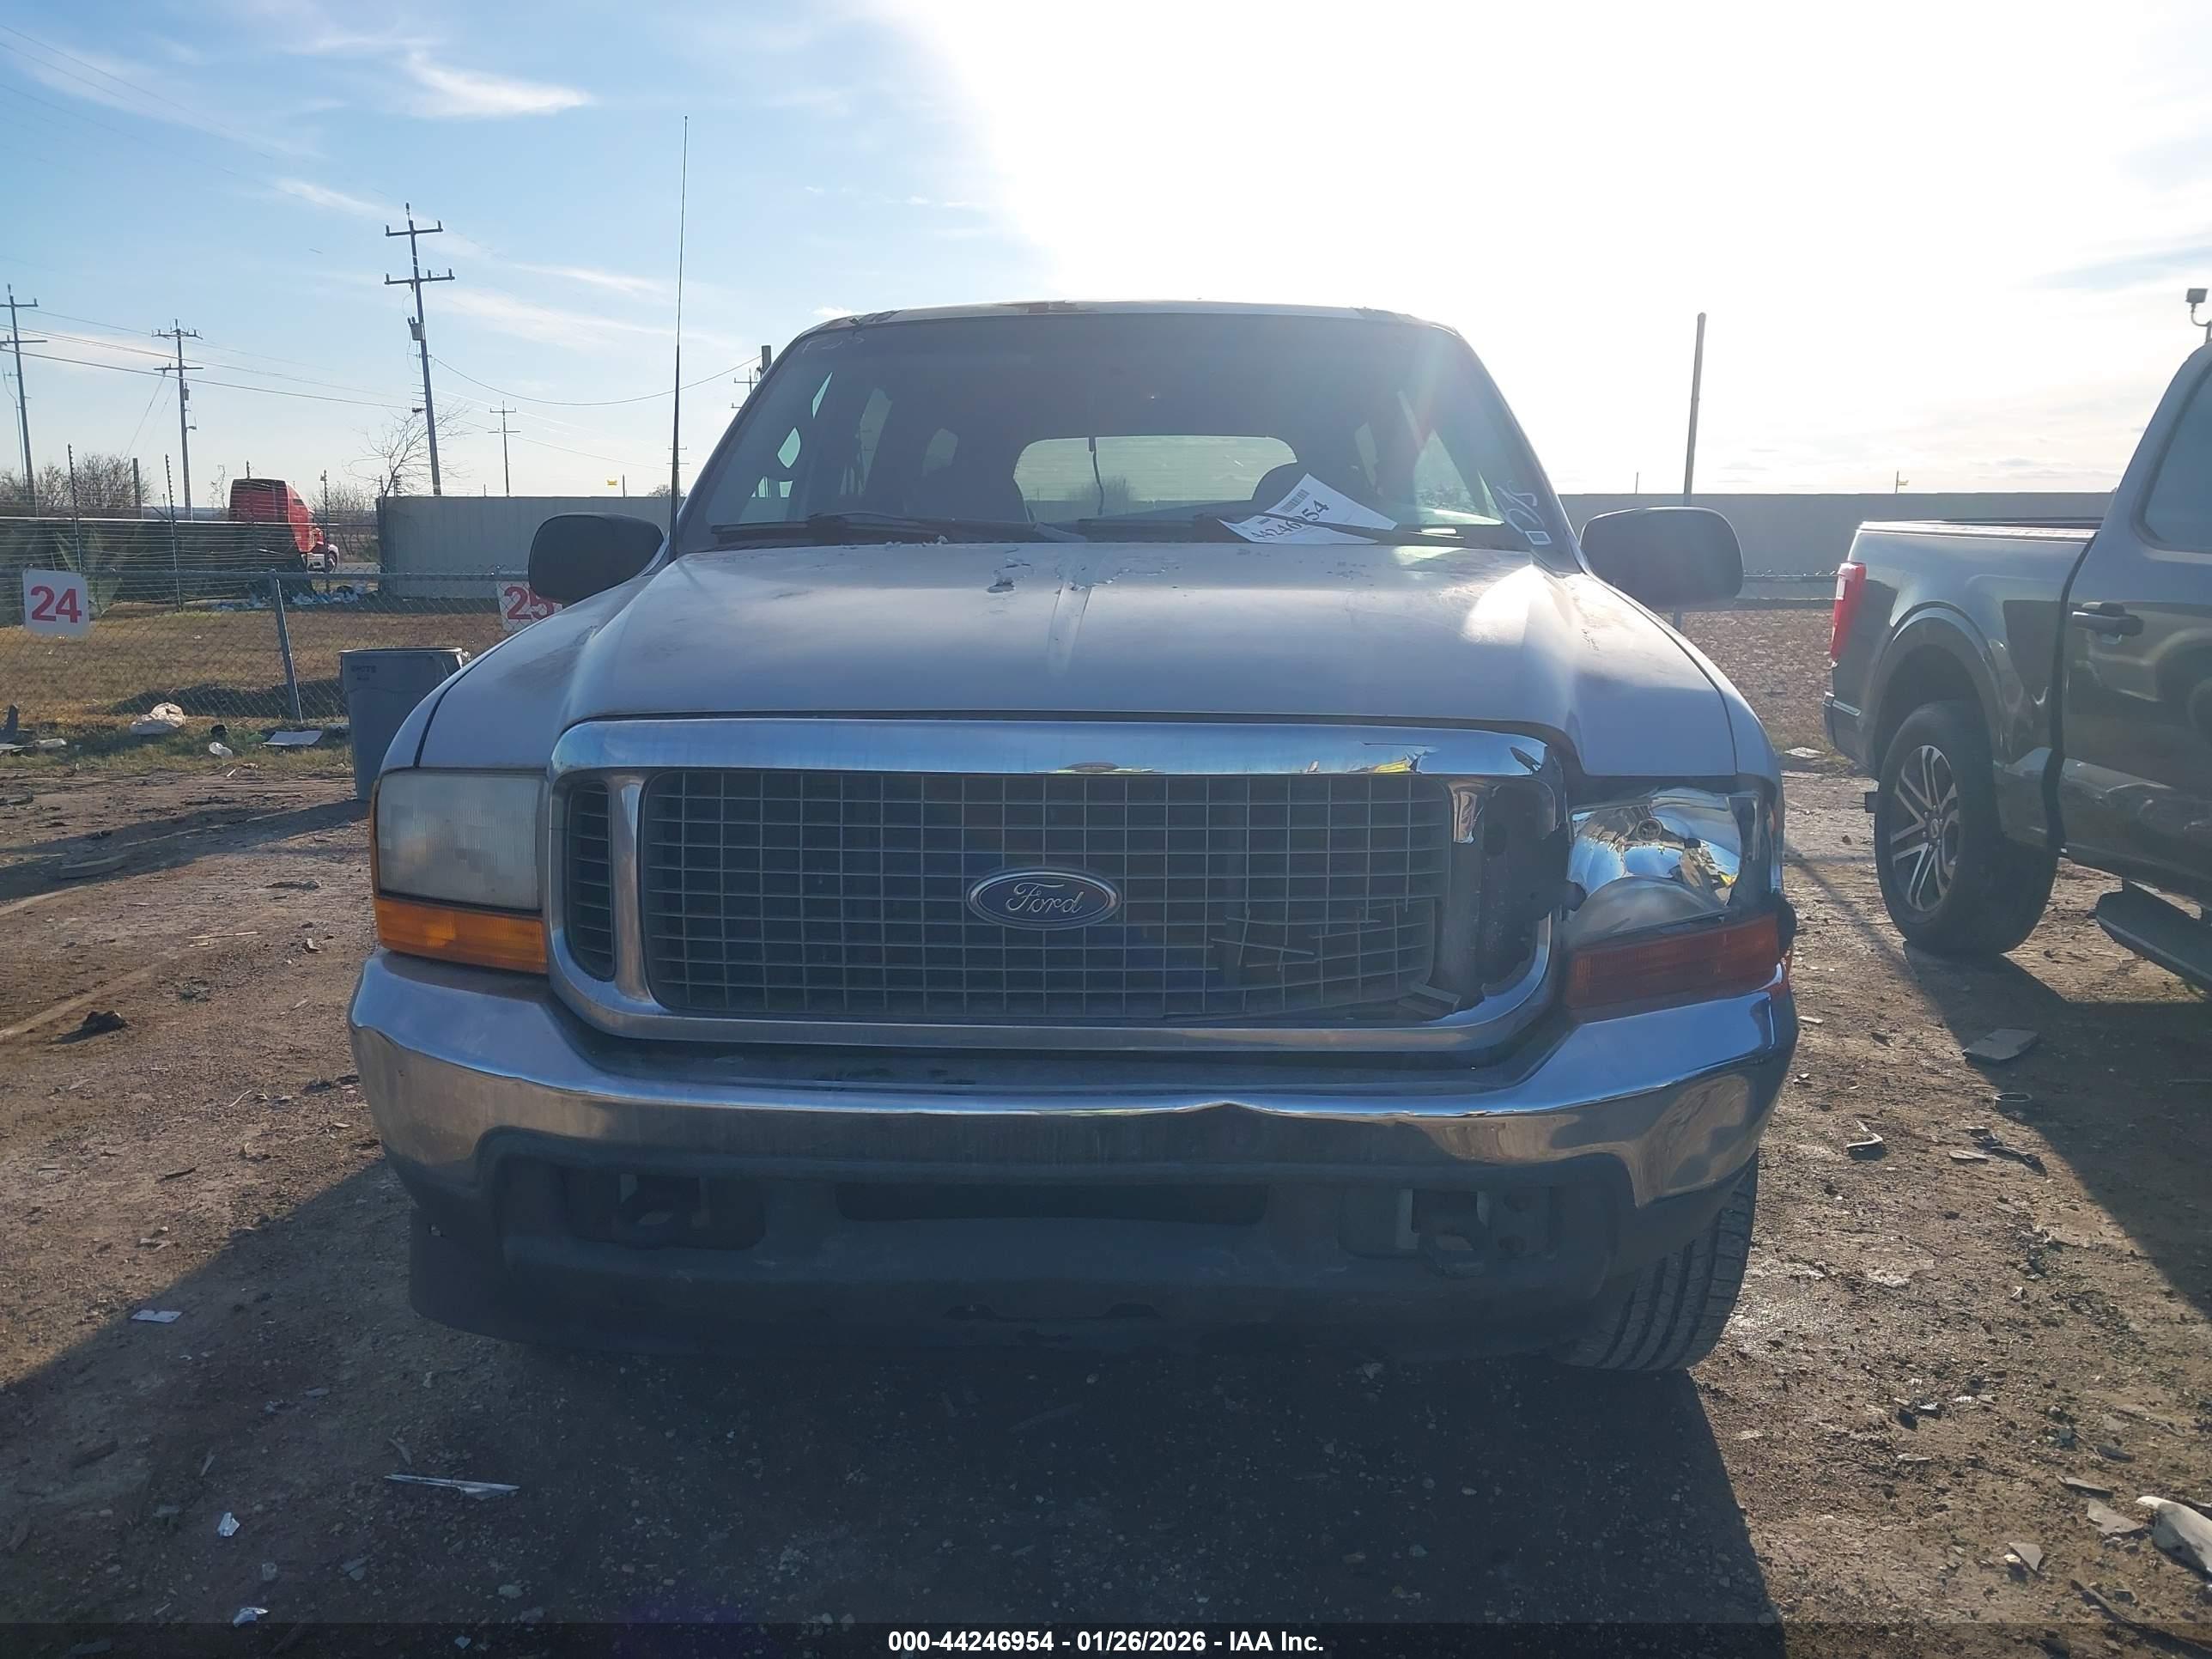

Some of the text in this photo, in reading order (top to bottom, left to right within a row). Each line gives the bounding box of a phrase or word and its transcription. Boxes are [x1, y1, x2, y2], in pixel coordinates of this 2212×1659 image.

[30, 586, 82, 623] 24
[504, 586, 555, 620] 25
[1005, 881, 1085, 915] Ford
